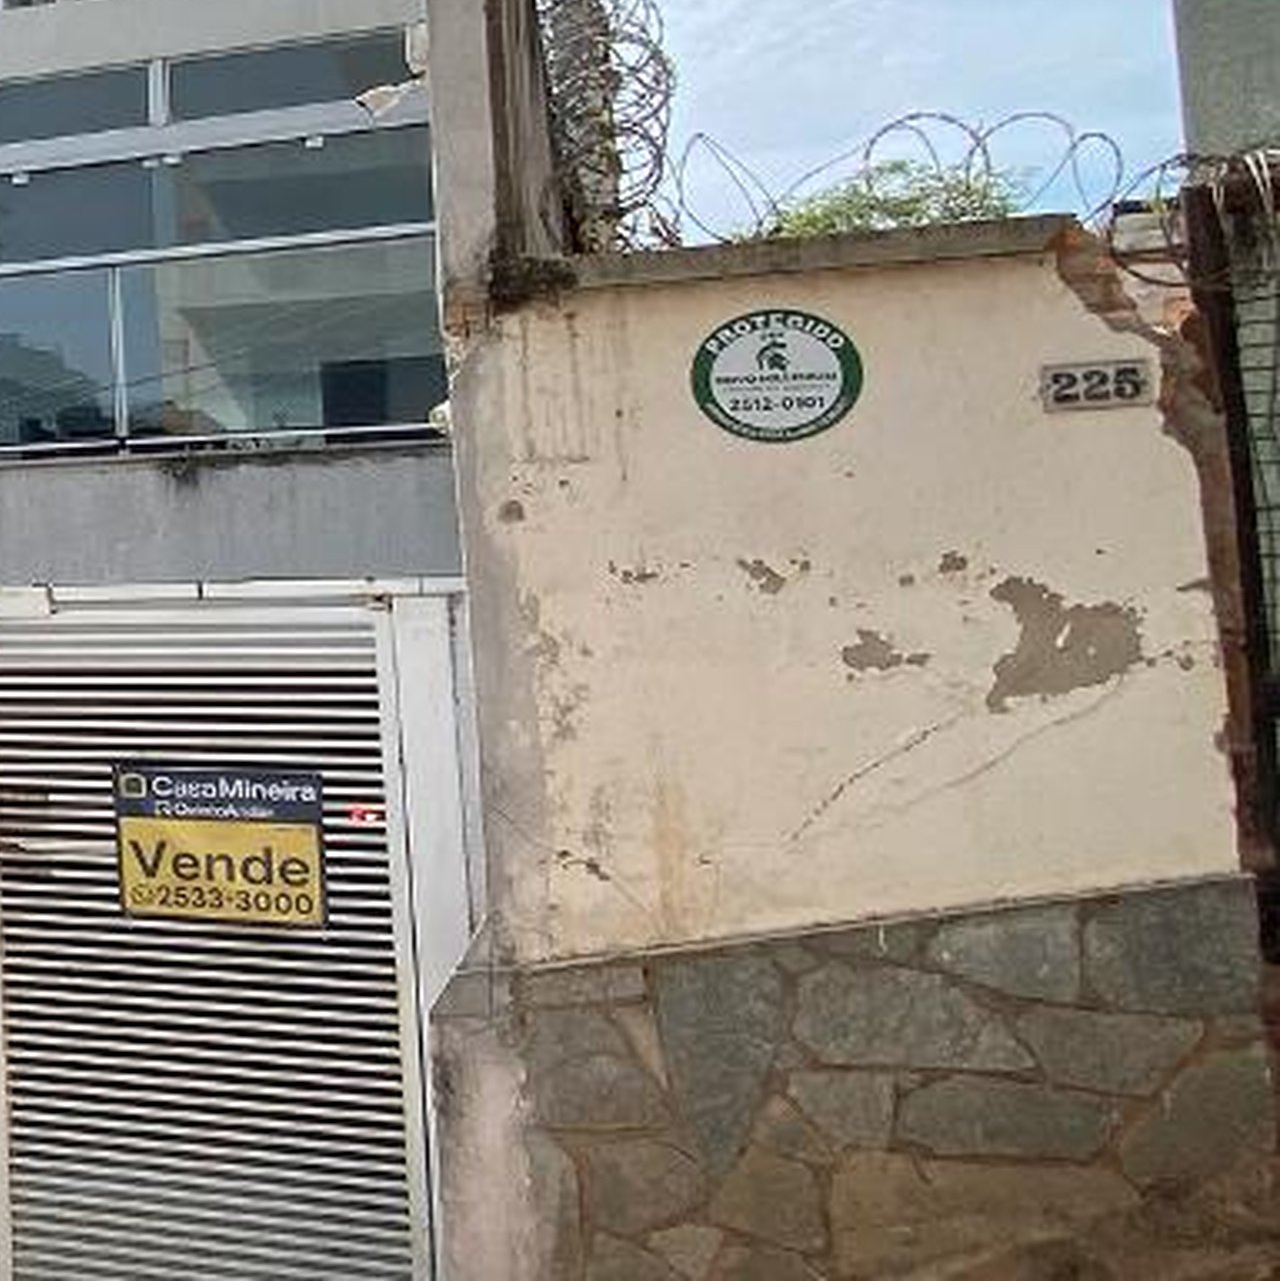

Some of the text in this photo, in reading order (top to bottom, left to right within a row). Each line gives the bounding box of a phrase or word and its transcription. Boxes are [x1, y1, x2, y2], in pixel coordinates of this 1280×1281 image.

[705, 314, 845, 354] PROTEGIDO
[1051, 367, 1141, 404] 225
[151, 775, 317, 802] CasaMineira
[129, 839, 311, 887] Vende
[157, 887, 315, 915] 2533-3000
